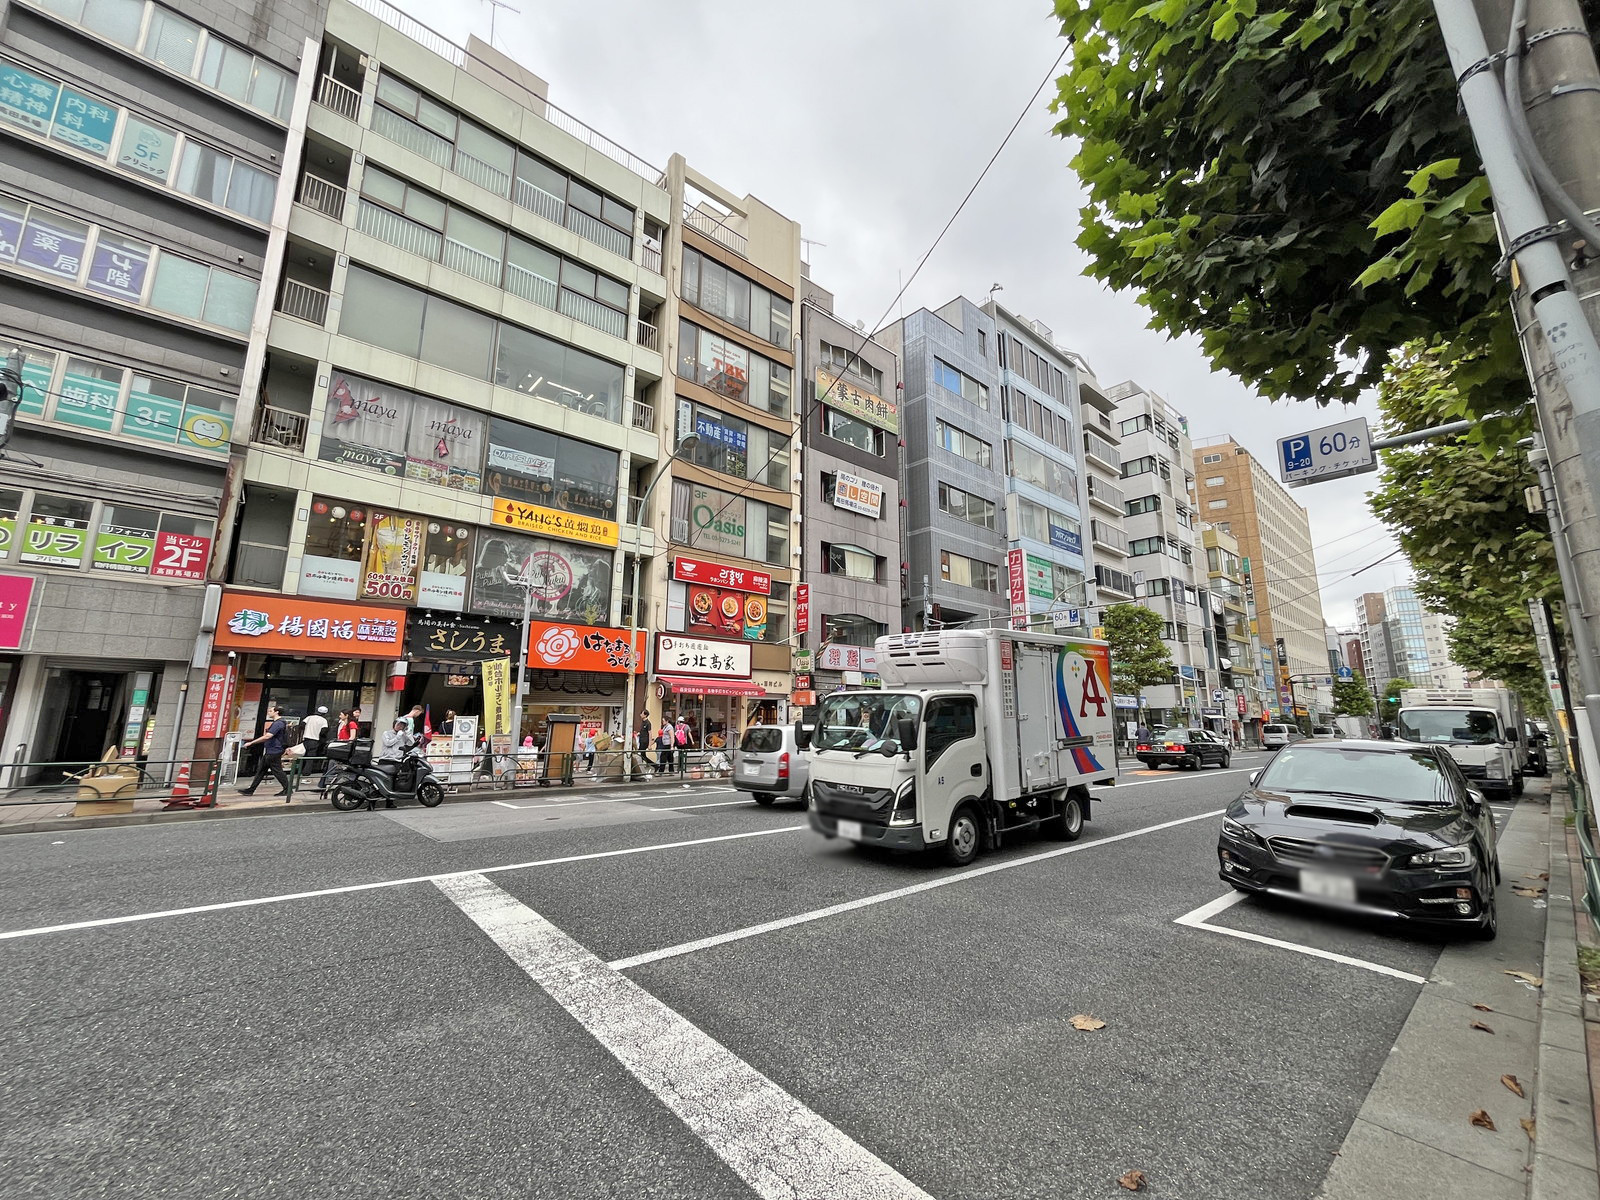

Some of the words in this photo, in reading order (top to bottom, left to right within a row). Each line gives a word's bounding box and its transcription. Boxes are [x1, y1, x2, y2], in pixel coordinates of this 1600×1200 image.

[56, 127, 105, 152] こころの
[134, 143, 161, 161] 5F
[122, 154, 165, 175] クリニック
[33, 231, 80, 273] 薬局
[712, 357, 747, 382] TBK
[61, 385, 115, 414] 歯科
[134, 406, 172, 428] 3F
[697, 421, 721, 440] 不動産
[1289, 440, 1305, 459] P
[1319, 432, 1361, 456] 60分
[342, 448, 382, 465] maya
[1288, 457, 1311, 470] 9-20
[694, 490, 707, 499] 3F
[518, 507, 562, 528] YANG'S
[693, 504, 744, 538] Oasis
[107, 526, 150, 538] リフォーム
[518, 520, 544, 530] BRAISED
[547, 526, 574, 536] CHICKEN
[575, 531, 588, 539] AND
[30, 530, 82, 551] リラ
[166, 535, 204, 548] 当ビル
[159, 545, 203, 568] 2F
[1010, 553, 1024, 602] カラオケ
[366, 580, 412, 599] 500円
[277, 615, 354, 640] 楊國福
[430, 628, 505, 654] さしうま
[583, 631, 631, 654] はなまる
[837, 784, 864, 795] ISUZU
